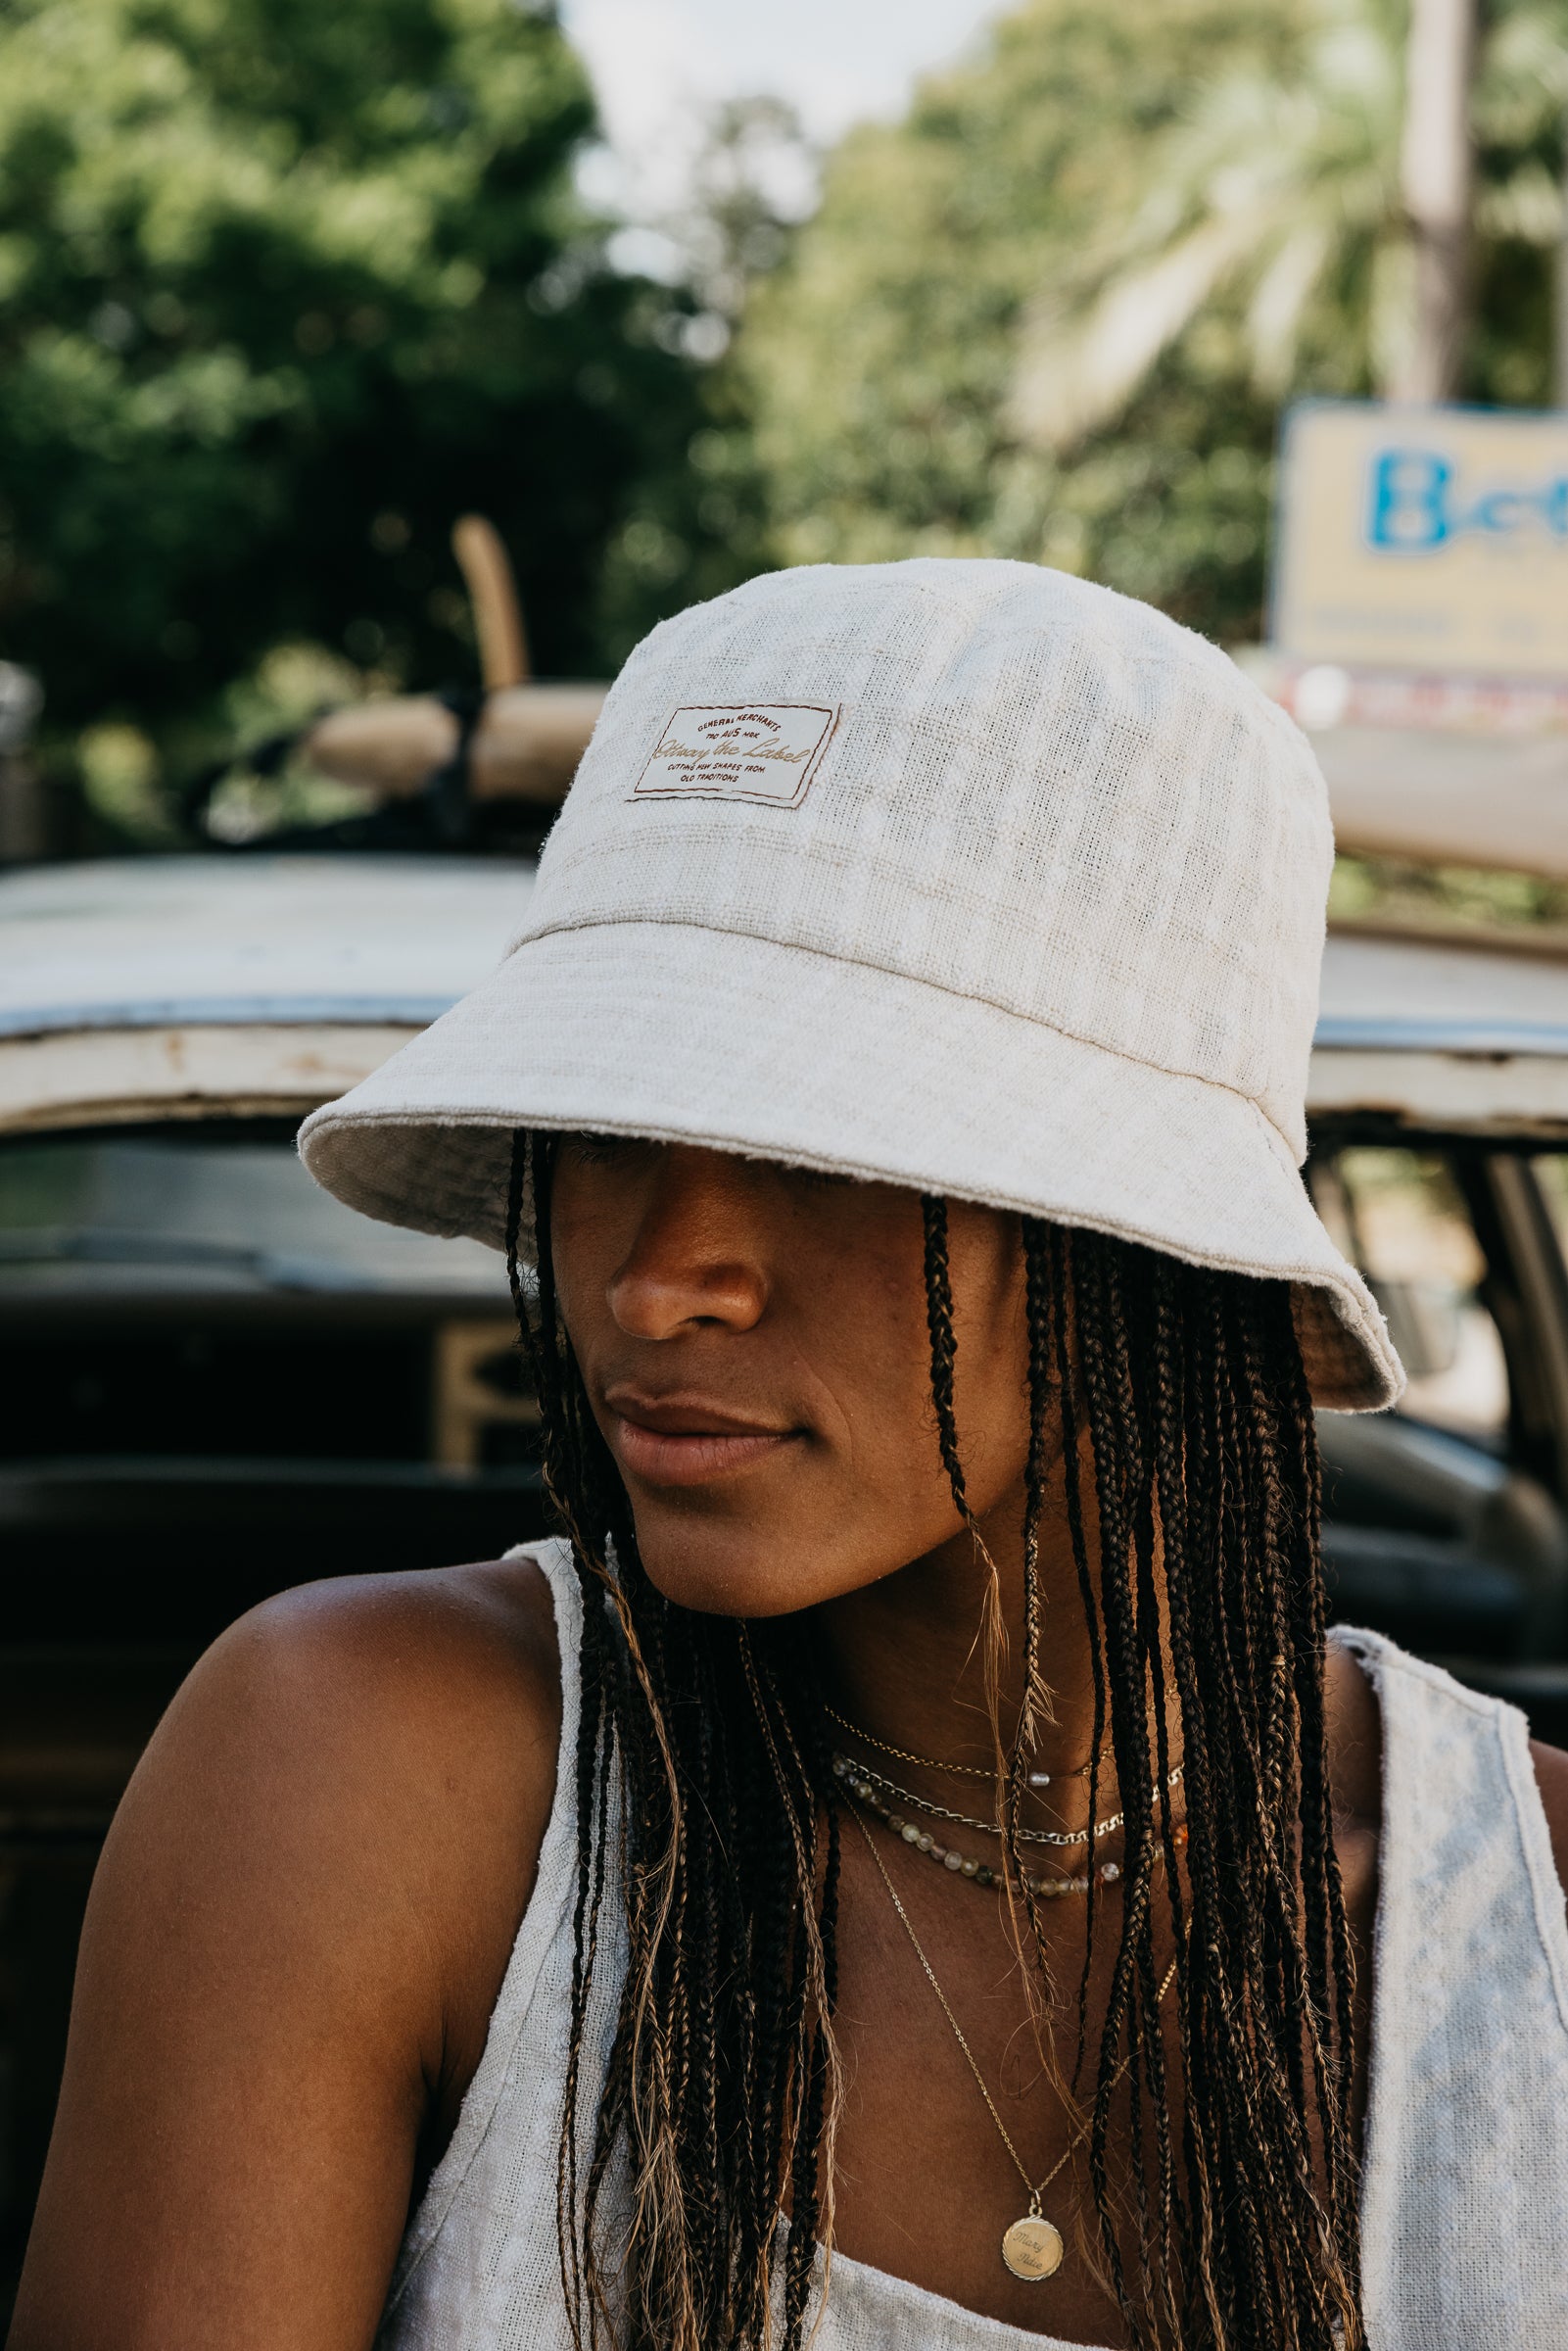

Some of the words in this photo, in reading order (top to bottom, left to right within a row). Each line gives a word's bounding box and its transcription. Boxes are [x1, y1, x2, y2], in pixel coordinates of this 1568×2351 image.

[697, 718, 735, 732] GENERAL
[736, 713, 782, 732] MERCHANTS
[721, 728, 741, 739] AUS
[713, 740, 740, 756] the
[742, 738, 811, 764] Label
[712, 762, 742, 772] SHAPES
[696, 773, 739, 783] TRADITIONS
[1013, 2231, 1044, 2253] Mary
